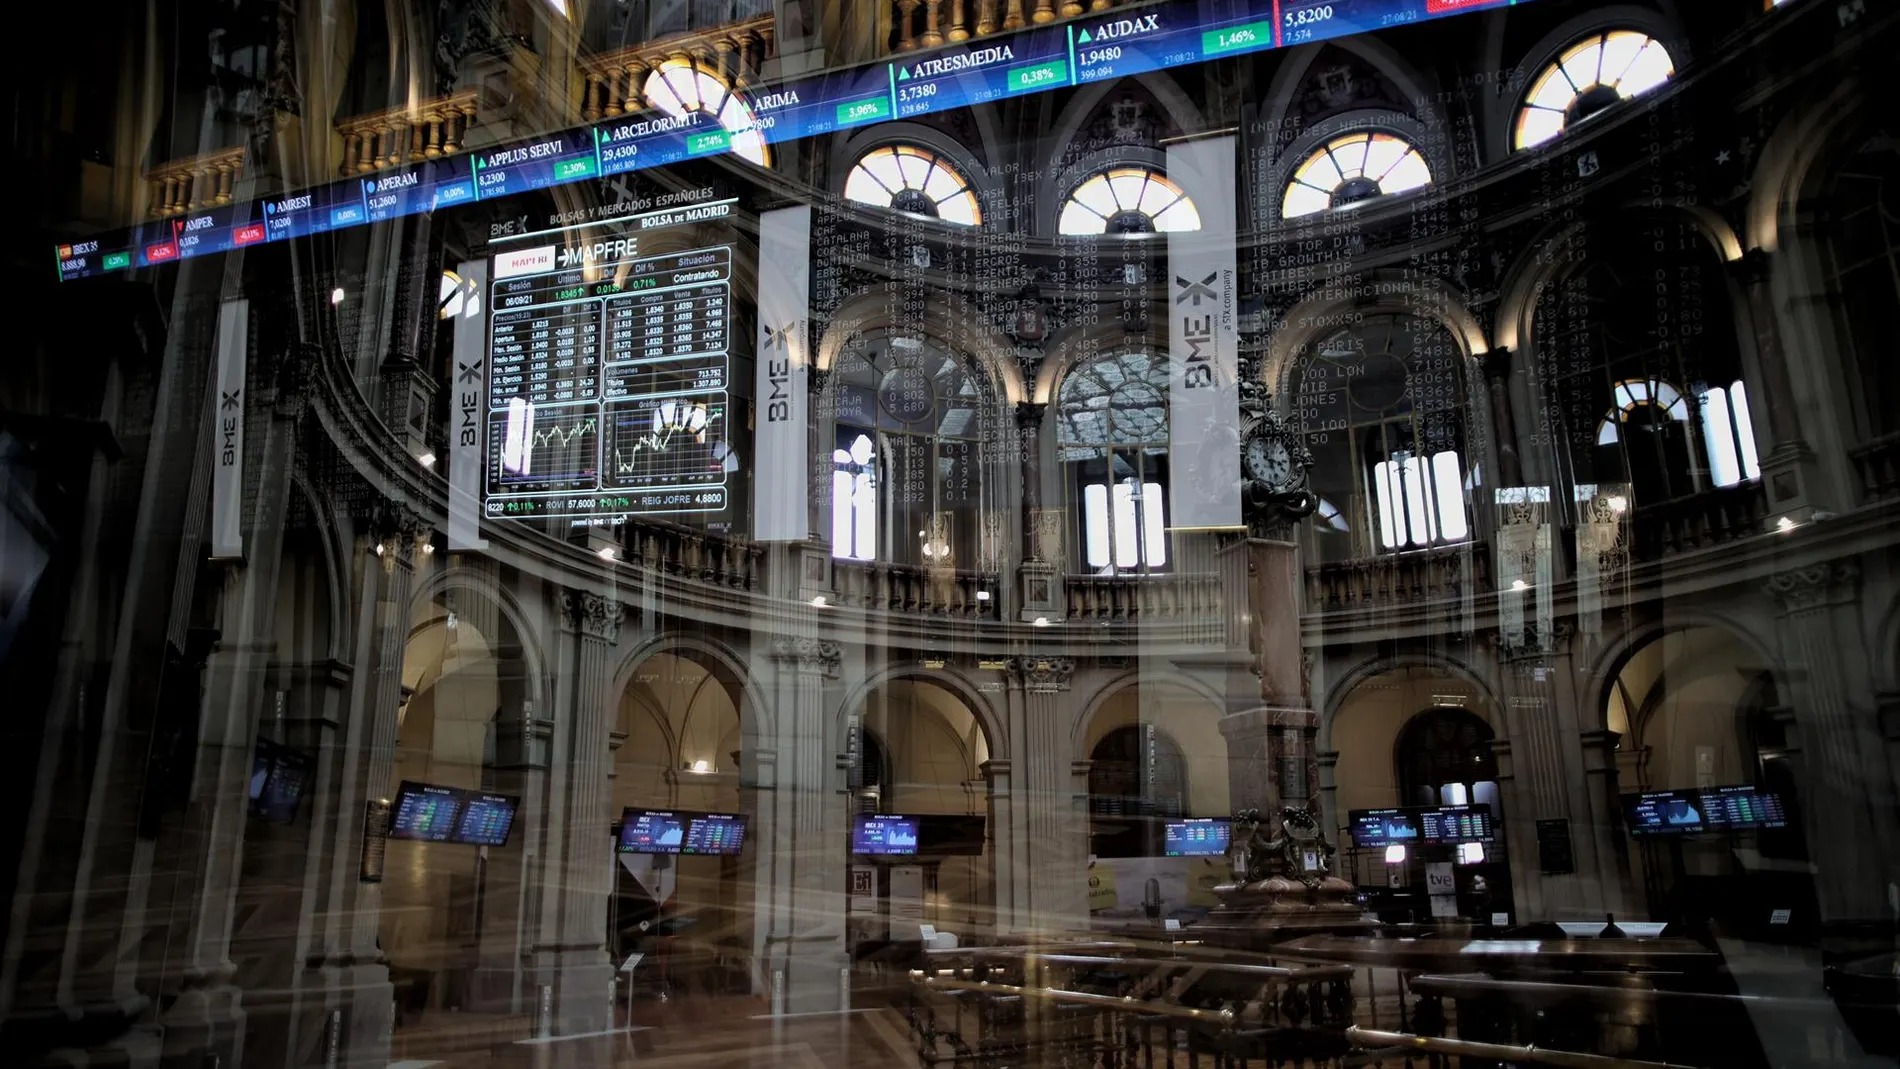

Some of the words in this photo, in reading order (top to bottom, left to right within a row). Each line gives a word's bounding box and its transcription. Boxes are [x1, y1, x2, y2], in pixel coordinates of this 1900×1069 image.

[1285, 6, 1333, 26] 5,8200
[1096, 14, 1160, 41] AUDAX
[1286, 29, 1313, 41] 7.574
[1219, 30, 1255, 47] 1,46%
[913, 45, 1014, 79] ATRESMEDIA
[1079, 46, 1121, 66] 1,9480
[1021, 68, 1054, 84] 0,38%
[1080, 67, 1113, 80] 399.094
[753, 90, 800, 112] ARIMA
[900, 84, 937, 102] 3,7380
[848, 103, 878, 118] 3,96%
[901, 101, 930, 114] 328.645
[698, 135, 723, 149] 2,74%
[488, 146, 528, 167] APPLUS
[530, 140, 563, 159] SERVI
[602, 145, 637, 162] 29,4300
[563, 162, 586, 174] 2,30%
[377, 172, 418, 191] APERAM
[479, 172, 506, 186] 8,2300
[444, 186, 465, 198] 0,00%
[276, 196, 312, 213] AMREST
[369, 195, 397, 209] 51,2600
[550, 211, 585, 225] BOLSAS
[588, 209, 595, 218] Y
[598, 195, 652, 216] MERCADOS
[656, 187, 714, 207] ESPAÑOLES
[185, 216, 214, 232] AMPER
[269, 217, 292, 229] 7,0200
[641, 214, 673, 229] BOLSA
[686, 204, 730, 221] MADRID
[817, 225, 837, 236] CAF
[817, 231, 870, 246] CATALANA
[179, 235, 199, 247] 0,1826
[1297, 240, 1323, 251] TOP
[569, 237, 638, 264] MAPFRE
[975, 255, 1020, 269] ERCROS
[508, 280, 532, 292] Sesión
[557, 272, 581, 284] Último
[678, 252, 715, 267] Situación
[633, 277, 656, 290] 0,71%
[673, 269, 719, 284] Contratando
[975, 264, 1028, 281] EZENTIS
[1252, 267, 1315, 283] LATIBEX
[1323, 262, 1352, 275] TOP
[1223, 269, 1232, 306] company
[1300, 278, 1441, 304] INTERNACIONALES
[1299, 312, 1364, 330] STOXX50
[1184, 314, 1211, 389] BME
[768, 358, 789, 422] BME
[460, 391, 477, 447] BME
[223, 417, 236, 466] BME
[567, 498, 596, 509] 57,6000
[642, 496, 662, 506] REIG
[663, 494, 691, 505] JOFRE
[695, 493, 722, 504] 4,8800
[1429, 872, 1453, 886] tve
